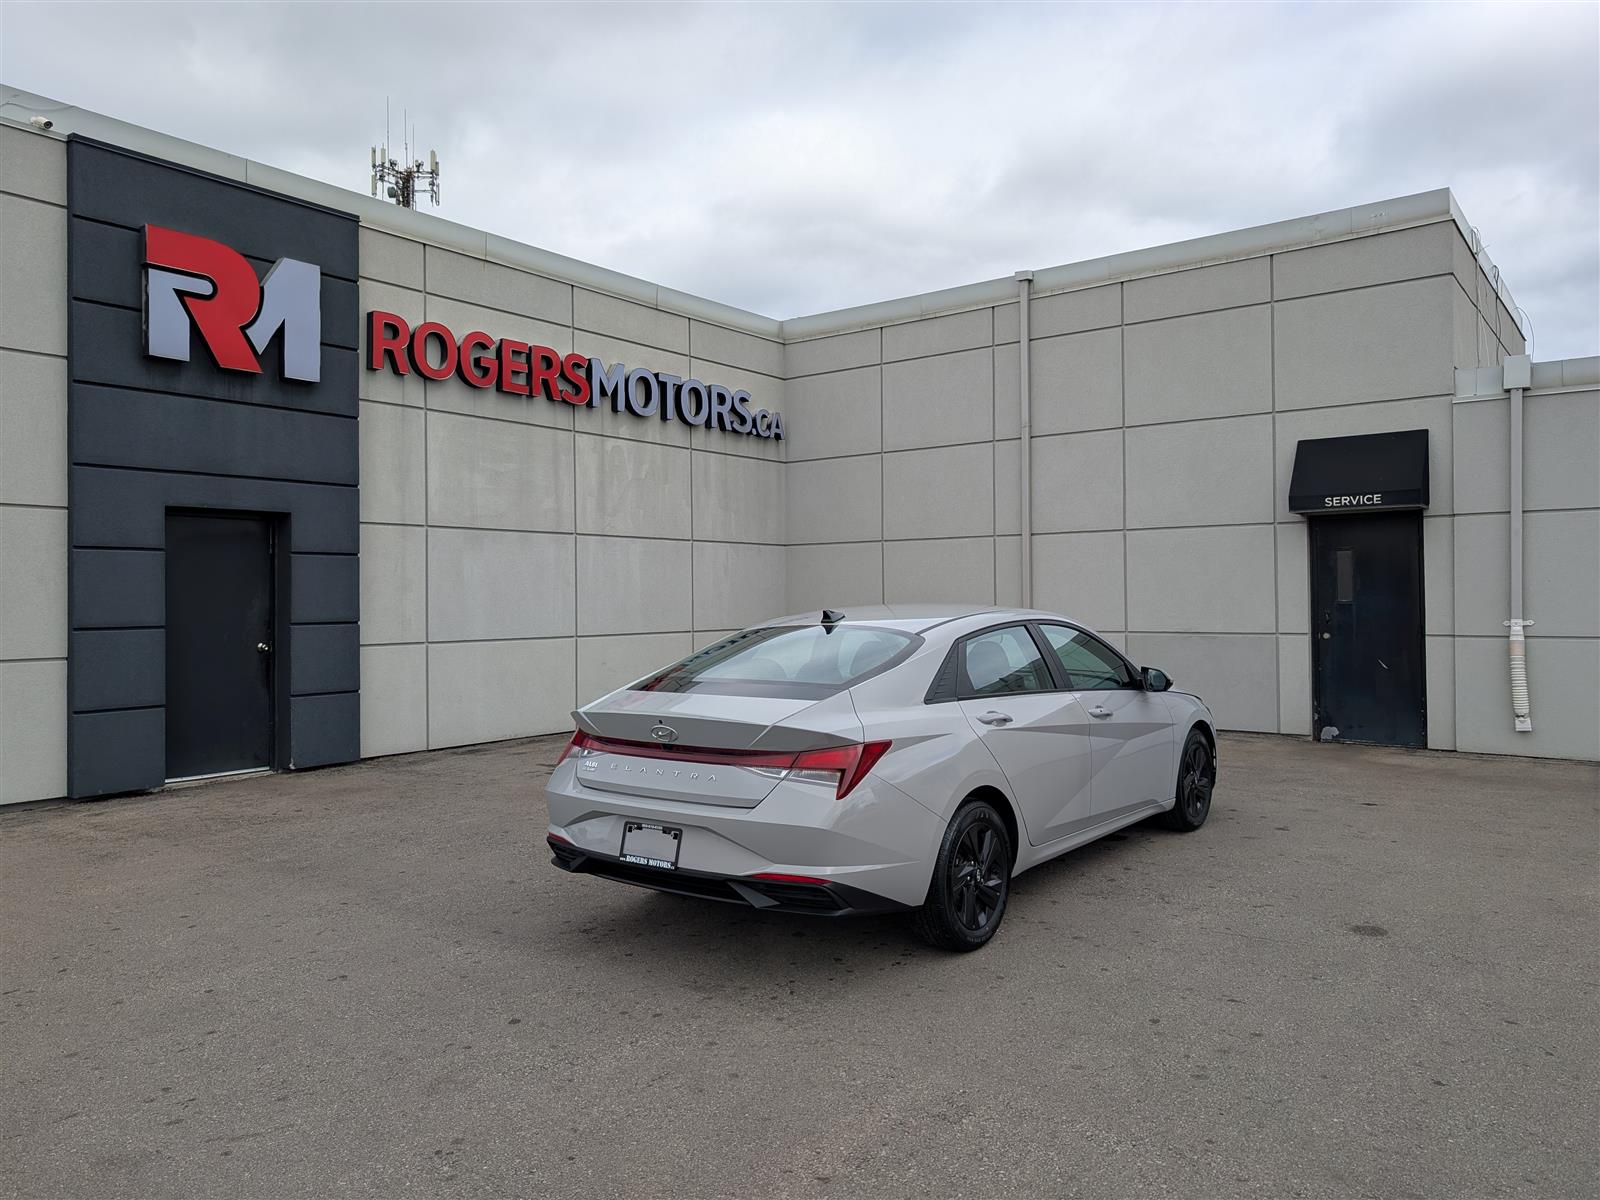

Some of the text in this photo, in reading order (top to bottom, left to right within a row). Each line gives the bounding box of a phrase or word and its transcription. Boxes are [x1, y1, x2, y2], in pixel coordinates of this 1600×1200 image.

[1324, 494, 1382, 507] SERVICE
[610, 763, 717, 782] ELANTRA
[625, 854, 648, 866] ROGERS
[648, 858, 672, 869] MOTORS
